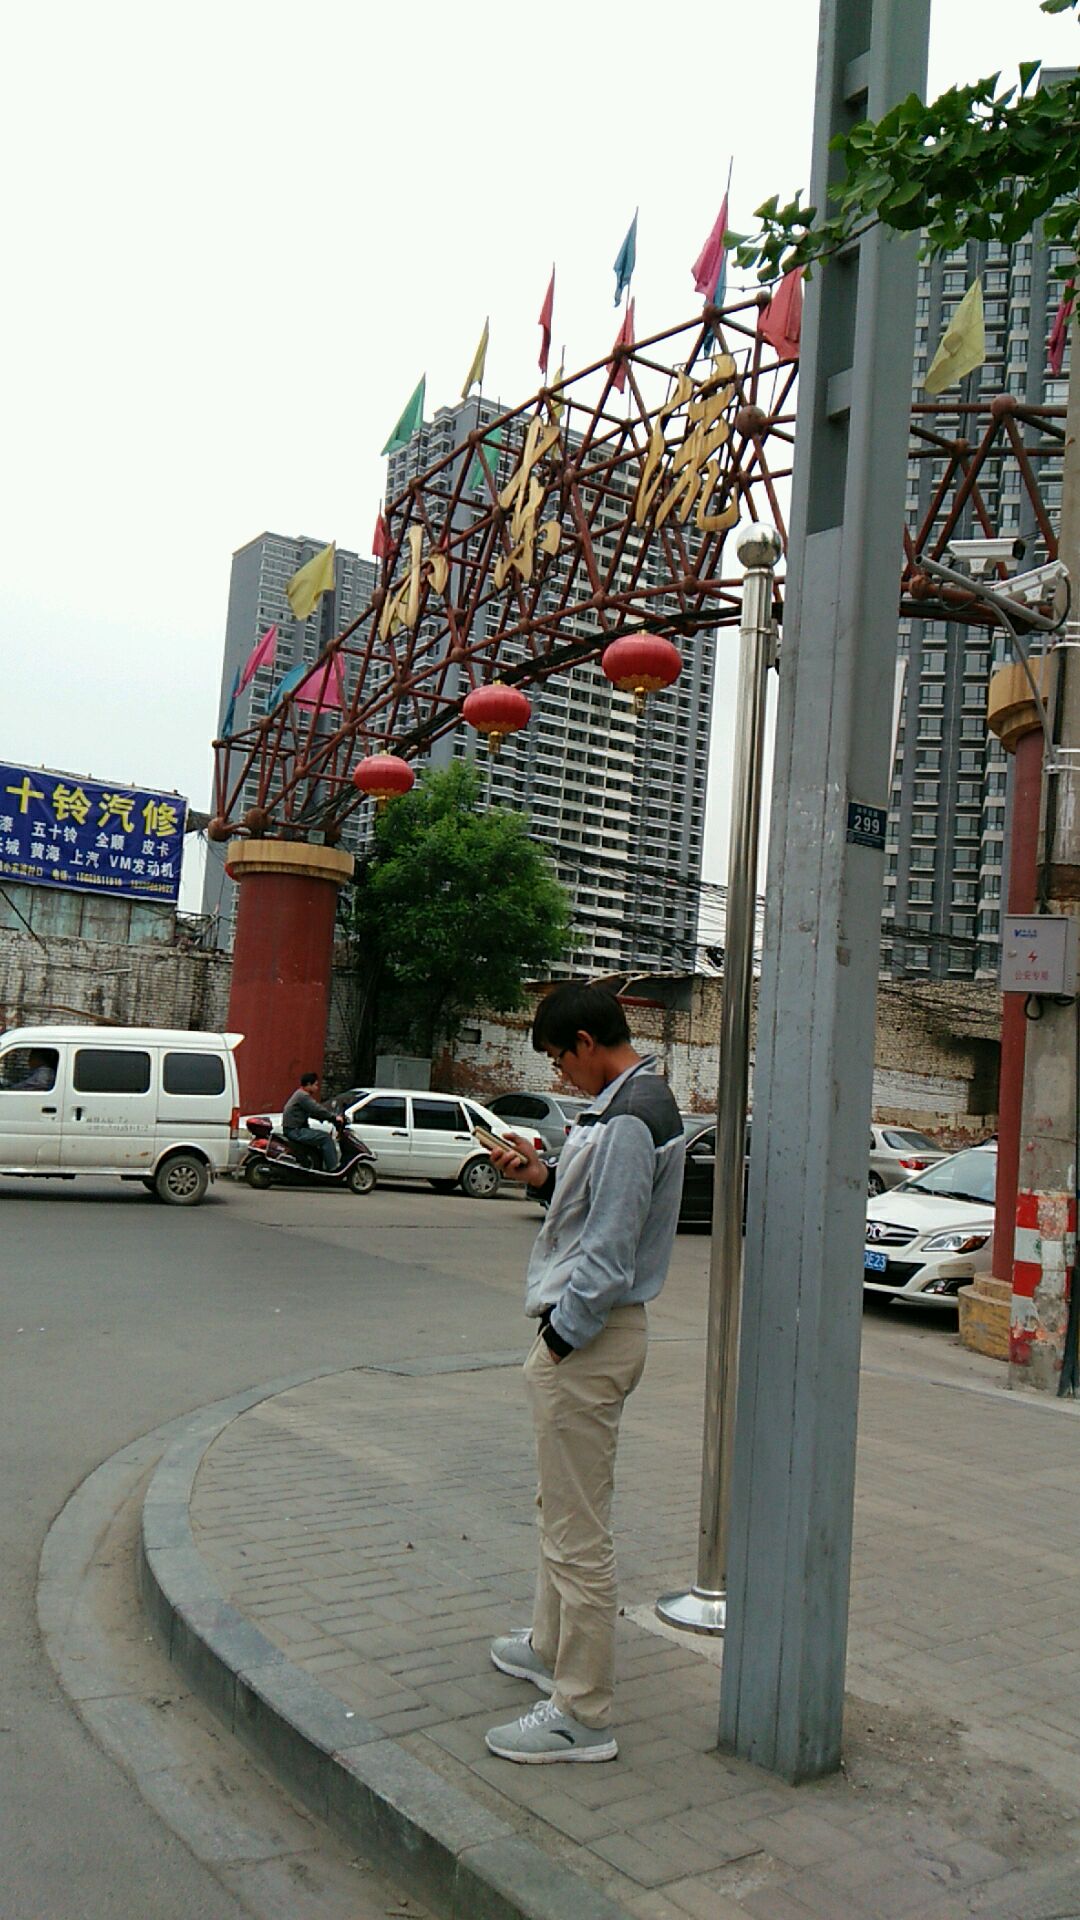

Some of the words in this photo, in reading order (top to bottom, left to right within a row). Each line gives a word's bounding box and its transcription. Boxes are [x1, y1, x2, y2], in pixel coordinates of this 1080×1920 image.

[6, 777, 178, 837] 十铃汽修
[854, 815, 880, 834] 299
[0, 837, 20, 856] 城
[31, 842, 60, 862] 黄海
[69, 849, 99, 869] 上汽
[109, 855, 174, 878] VM发动机
[31, 821, 78, 844] 五十铃
[95, 832, 125, 851] 全顺
[141, 839, 169, 857] 皮卡
